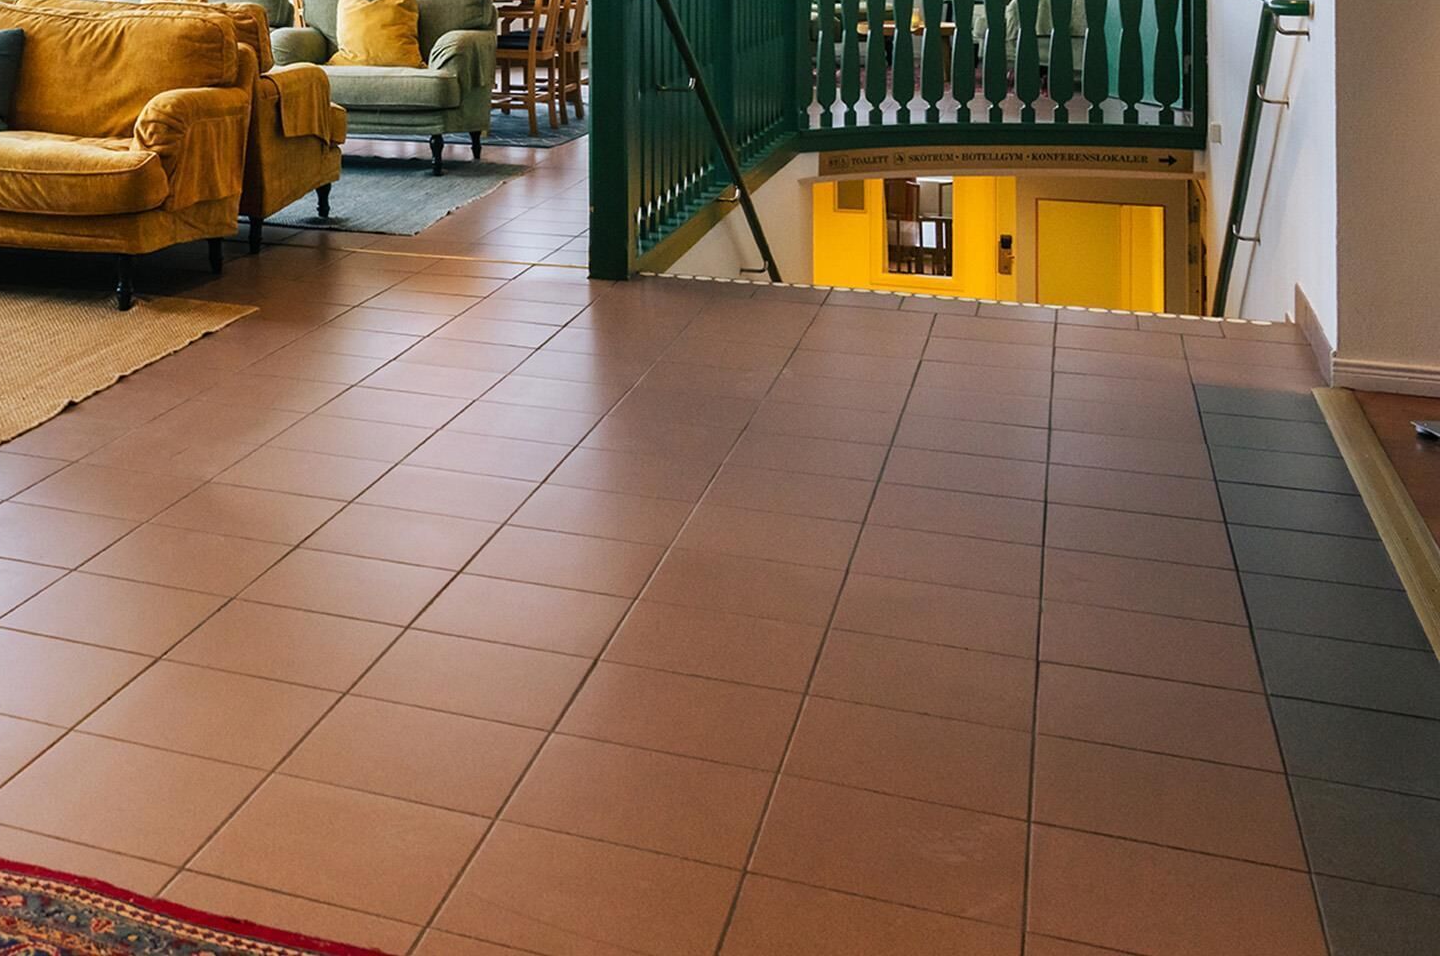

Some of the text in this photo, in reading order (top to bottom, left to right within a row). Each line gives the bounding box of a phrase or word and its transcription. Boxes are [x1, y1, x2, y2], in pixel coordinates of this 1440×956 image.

[851, 155, 889, 165] TOALETT
[961, 152, 1023, 162] HOTELLGYM
[1031, 152, 1148, 163] KONFERENSLOKALER
